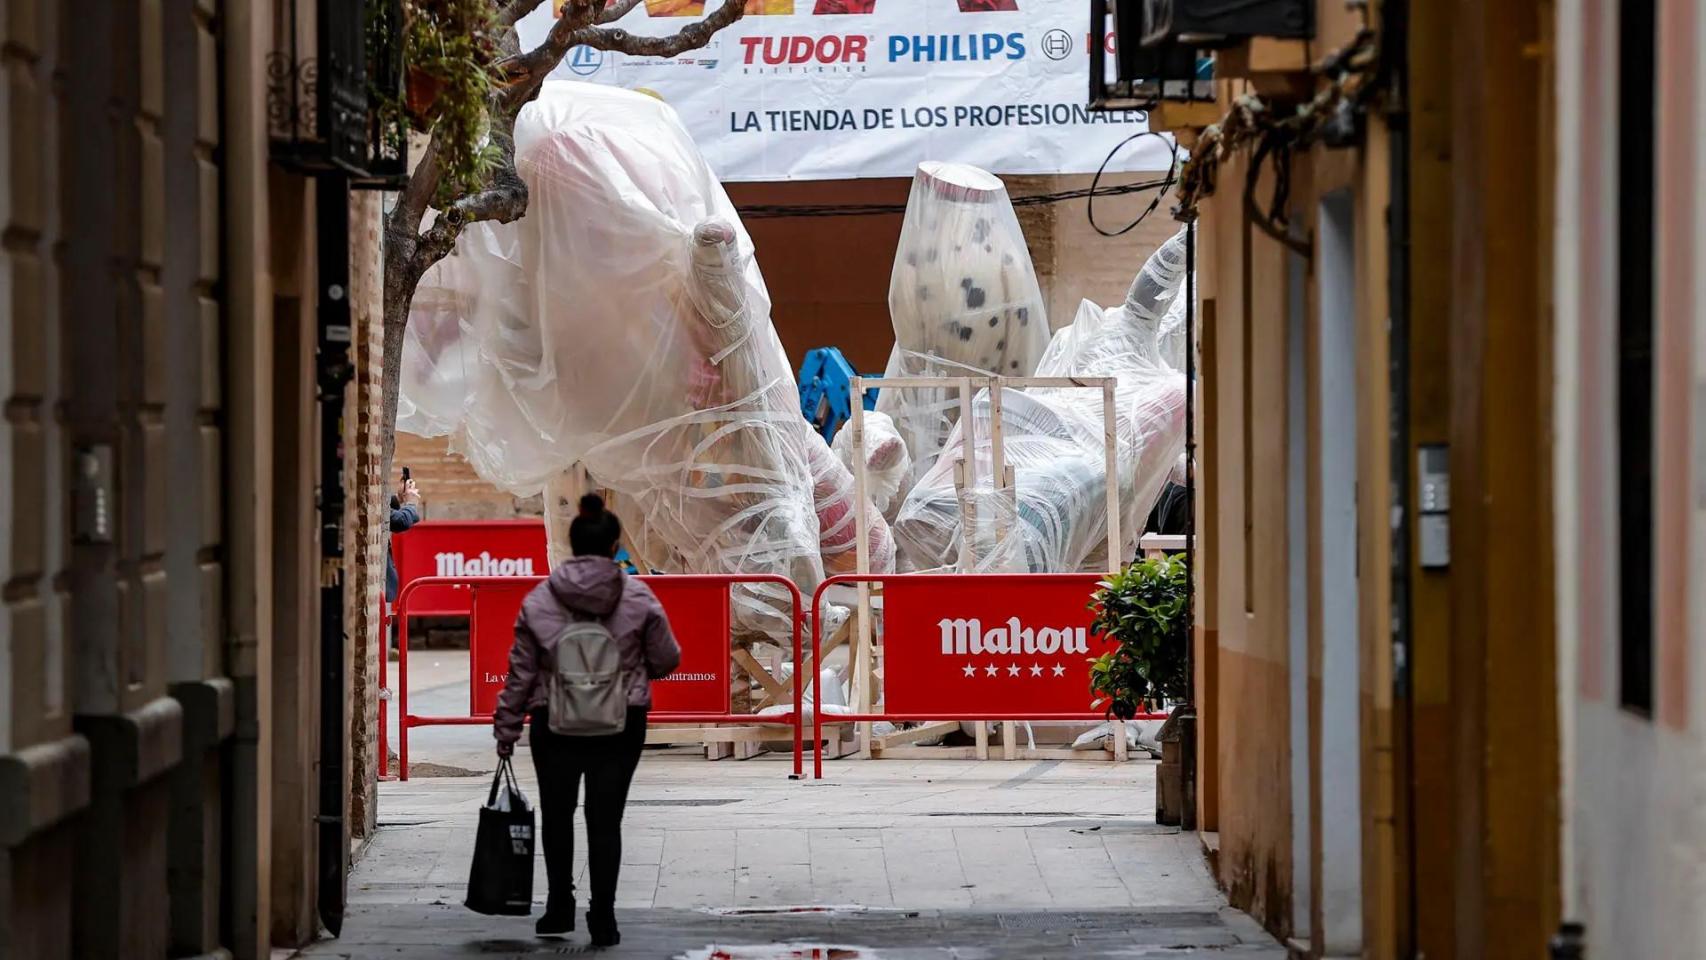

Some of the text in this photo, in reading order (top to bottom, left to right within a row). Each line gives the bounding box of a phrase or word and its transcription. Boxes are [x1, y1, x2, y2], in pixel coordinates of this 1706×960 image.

[740, 35, 868, 65] TUDOR
[888, 33, 1026, 62] PHILIPS
[730, 103, 1148, 133] LA TIENDA DE LOS PROFESIONALES
[434, 551, 535, 577] Mahou
[938, 616, 1089, 656] Mahou
[485, 672, 498, 683] La
